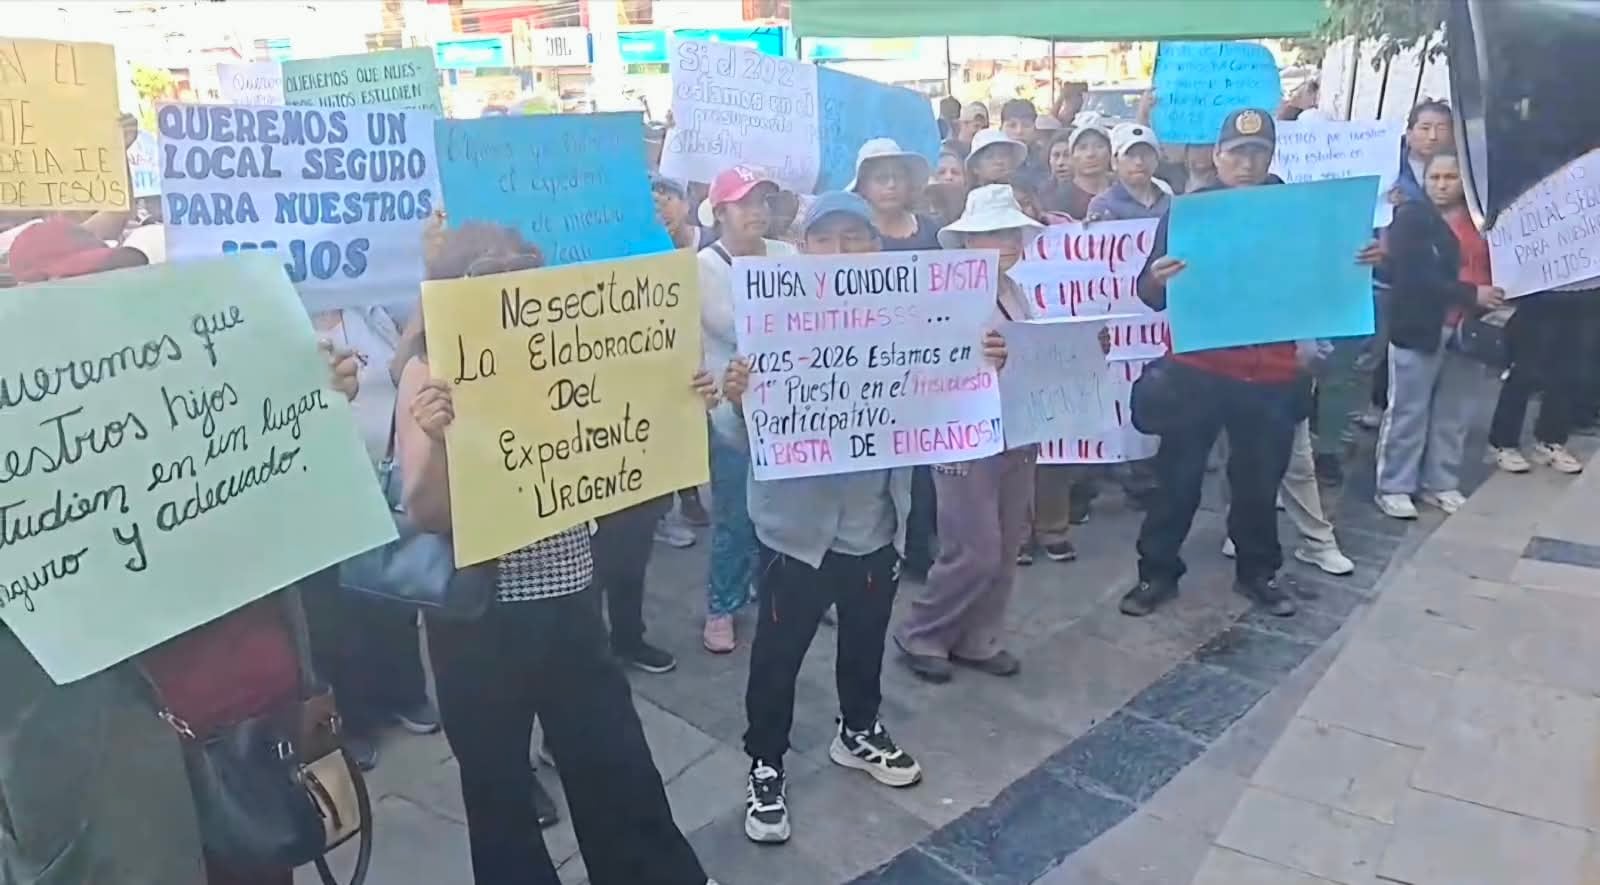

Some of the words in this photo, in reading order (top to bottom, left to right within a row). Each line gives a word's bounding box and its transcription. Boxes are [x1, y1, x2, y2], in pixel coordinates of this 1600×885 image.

[55, 43, 86, 86] EL
[286, 70, 349, 93] QUEREMOS
[356, 69, 378, 83] QUE
[361, 84, 422, 104] ESTUDIEN
[158, 106, 350, 145] QUEREMOS
[366, 112, 408, 145] UN
[163, 144, 282, 179] LOCAL
[302, 147, 427, 182] SEGURO
[0, 181, 29, 207] DE
[38, 174, 126, 207] JESÚS
[166, 191, 260, 226] PARA
[274, 188, 434, 225] NUESTROS
[222, 239, 370, 283] JOS
[1514, 239, 1550, 265] PARA
[192, 305, 244, 367] que
[454, 335, 496, 385] La
[747, 345, 859, 374] 2025-2026
[868, 341, 940, 369] Estamos
[950, 345, 971, 362] en
[548, 374, 602, 412] Del
[784, 371, 850, 405] Puesto
[861, 380, 883, 400] en
[889, 369, 911, 398] el
[161, 382, 239, 438] hijos
[751, 400, 896, 437] Participativo.
[147, 455, 197, 492] en
[205, 426, 248, 468] un
[261, 388, 329, 441] lugar
[849, 433, 877, 458] DE
[113, 522, 148, 572] y
[156, 448, 308, 532] adecuado.
